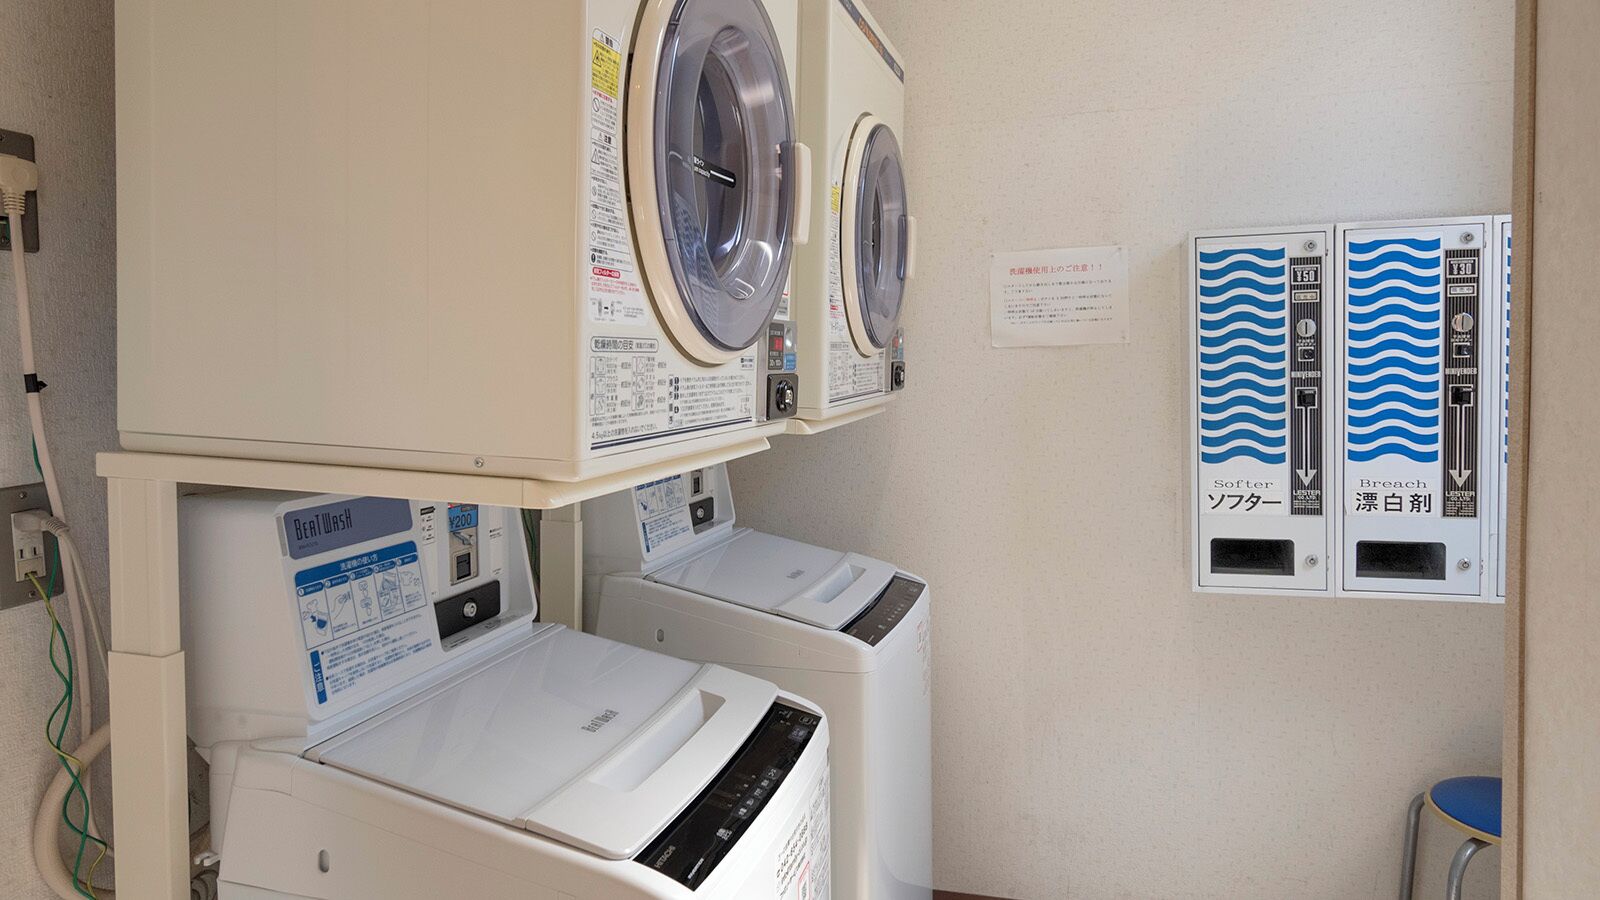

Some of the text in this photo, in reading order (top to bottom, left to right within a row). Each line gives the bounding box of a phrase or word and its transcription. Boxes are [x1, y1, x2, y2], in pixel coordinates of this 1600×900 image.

[1296, 270, 1315, 282] ¥50
[1452, 263, 1472, 275] ¥30
[1214, 479, 1273, 489] Softer
[1359, 479, 1428, 489] Breach
[1208, 492, 1282, 511] ソフター
[1355, 492, 1432, 513] 漂白剤
[449, 513, 472, 530] ¥200
[654, 845, 677, 869] HITACHI
